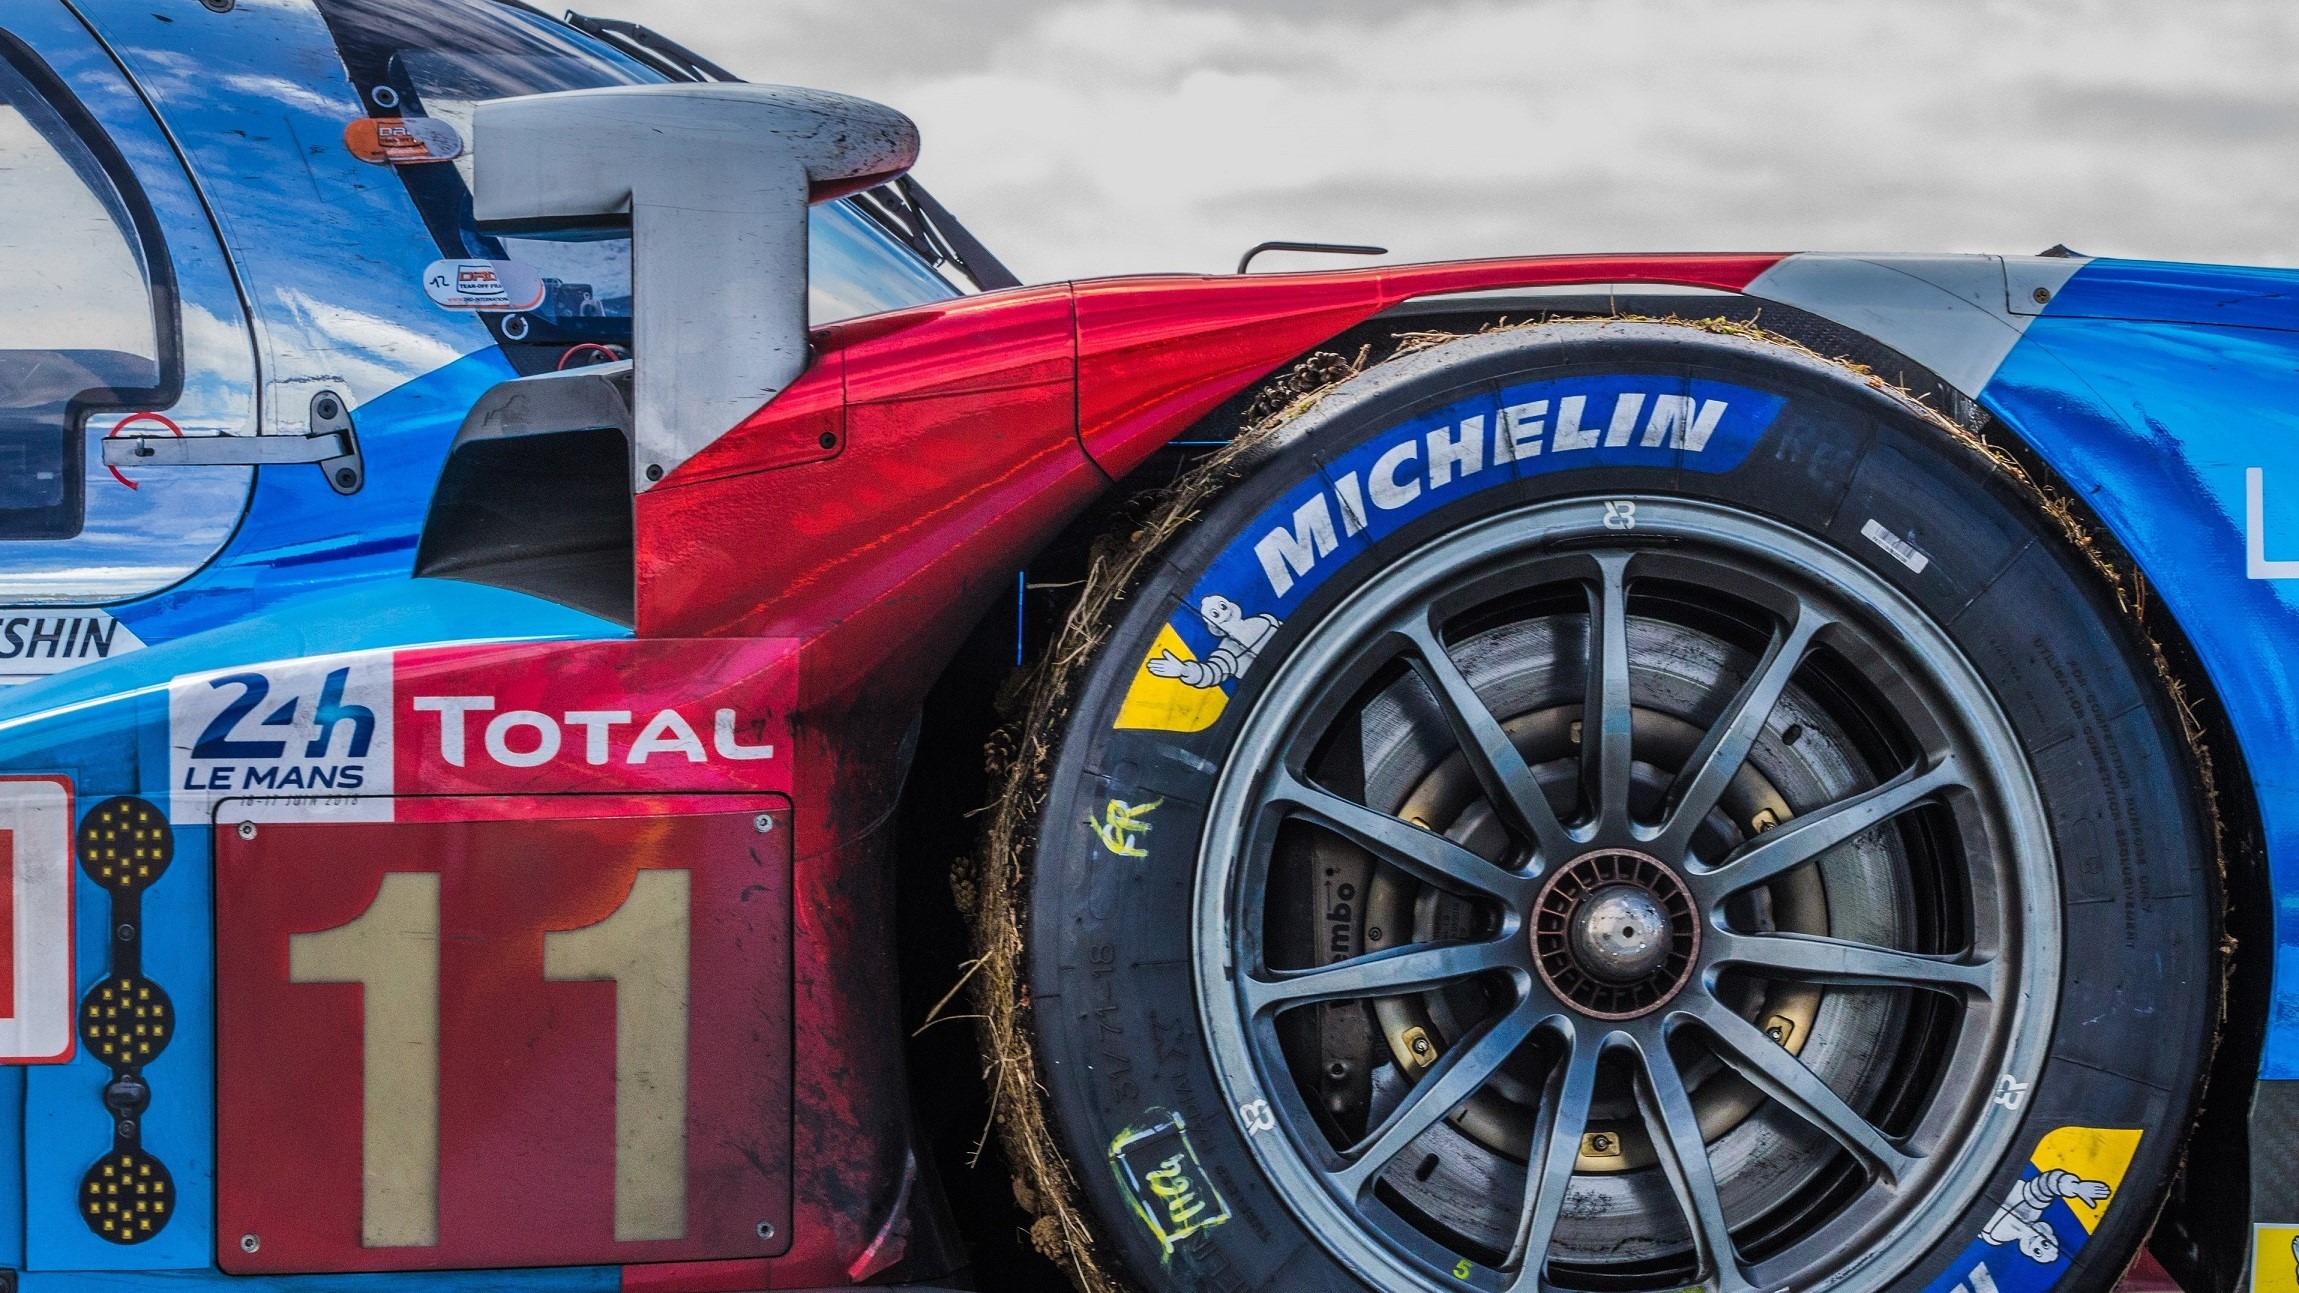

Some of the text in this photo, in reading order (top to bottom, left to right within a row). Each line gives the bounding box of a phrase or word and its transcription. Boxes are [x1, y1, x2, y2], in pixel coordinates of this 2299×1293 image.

[1253, 392, 1729, 599] MICHELIN
[0, 617, 119, 659] SHIN
[190, 666, 376, 760] 24h
[184, 765, 364, 790] LE MANS
[289, 868, 692, 1248] 11
[1452, 1258, 1474, 1280] 5
